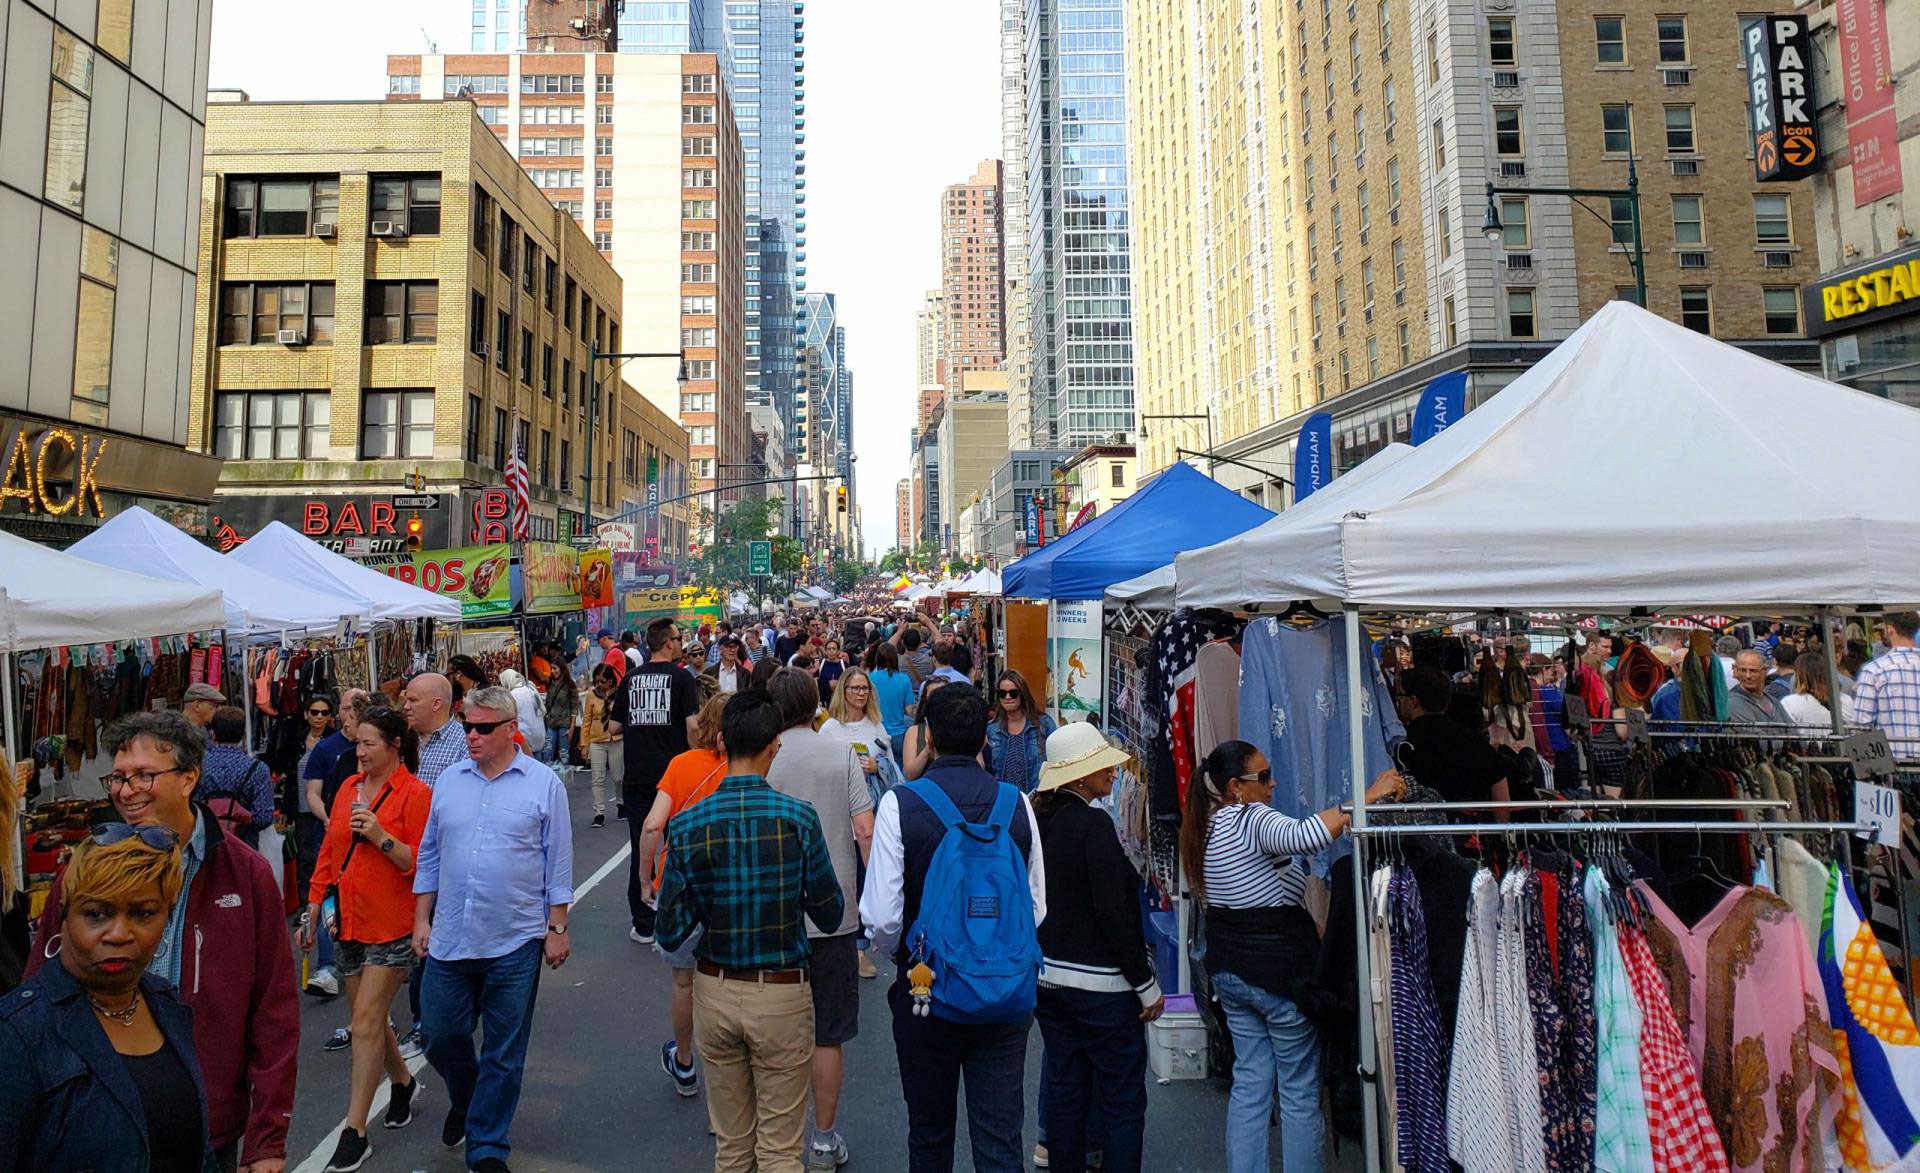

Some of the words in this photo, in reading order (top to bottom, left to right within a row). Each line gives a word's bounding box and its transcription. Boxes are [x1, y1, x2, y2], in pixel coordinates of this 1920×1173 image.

[1748, 27, 1771, 131] PARK
[1775, 20, 1810, 123] PARK
[1756, 130, 1775, 145] icon
[1783, 126, 1813, 136] icon
[0, 427, 107, 519] ACK
[303, 501, 398, 536] BAR
[1028, 502, 1037, 537] PARK
[364, 555, 393, 567] RUNS
[398, 553, 414, 563] ON
[372, 560, 466, 593] ROS
[1062, 616, 1087, 624] WEEKS
[630, 674, 670, 689] STRAIGHT
[631, 689, 667, 710] OUTTA
[1869, 788, 1894, 818] $10
